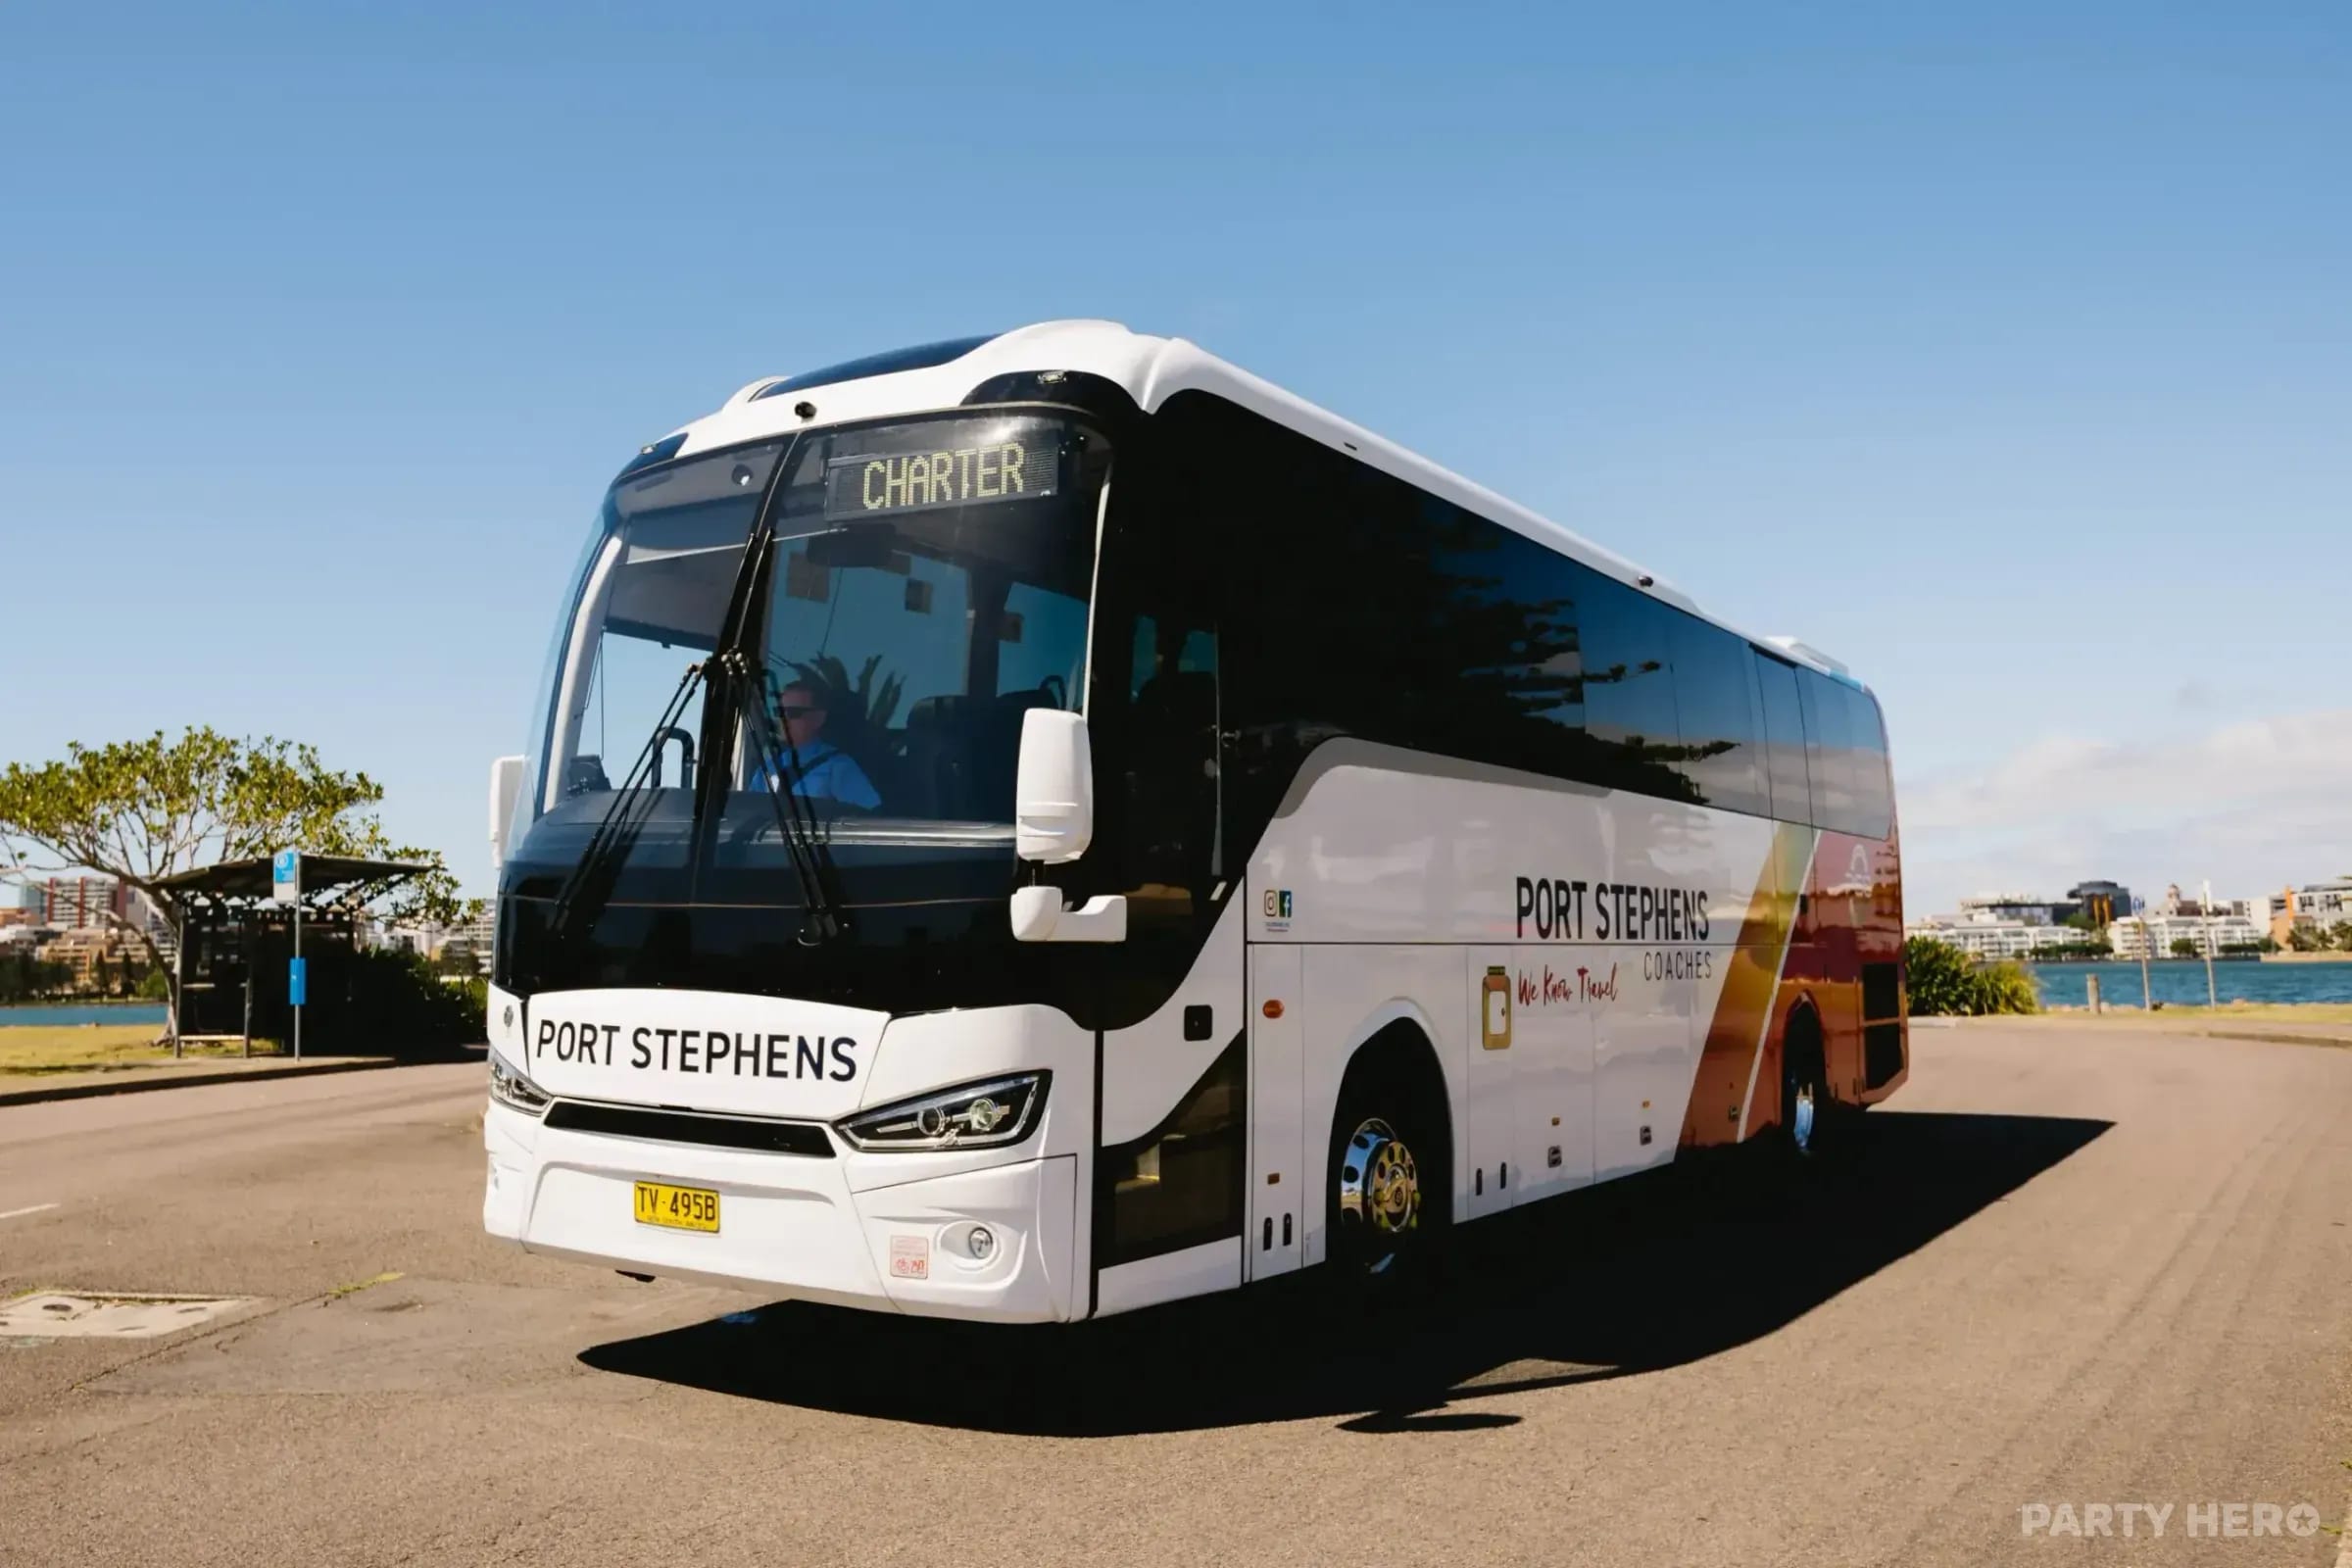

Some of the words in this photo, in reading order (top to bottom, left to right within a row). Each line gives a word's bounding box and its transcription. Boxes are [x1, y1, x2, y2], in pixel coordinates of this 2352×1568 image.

[862, 442, 1025, 511] CHARTER
[1516, 876, 1587, 940] PORT
[1595, 882, 1709, 941] STEPHENS
[1519, 967, 1539, 1006] We
[1544, 964, 1573, 1006] Know
[1577, 962, 1618, 1004] Travel
[1643, 951, 1712, 981] COACHES
[537, 1019, 620, 1066] PORT
[630, 1027, 858, 1083] STEPHENS
